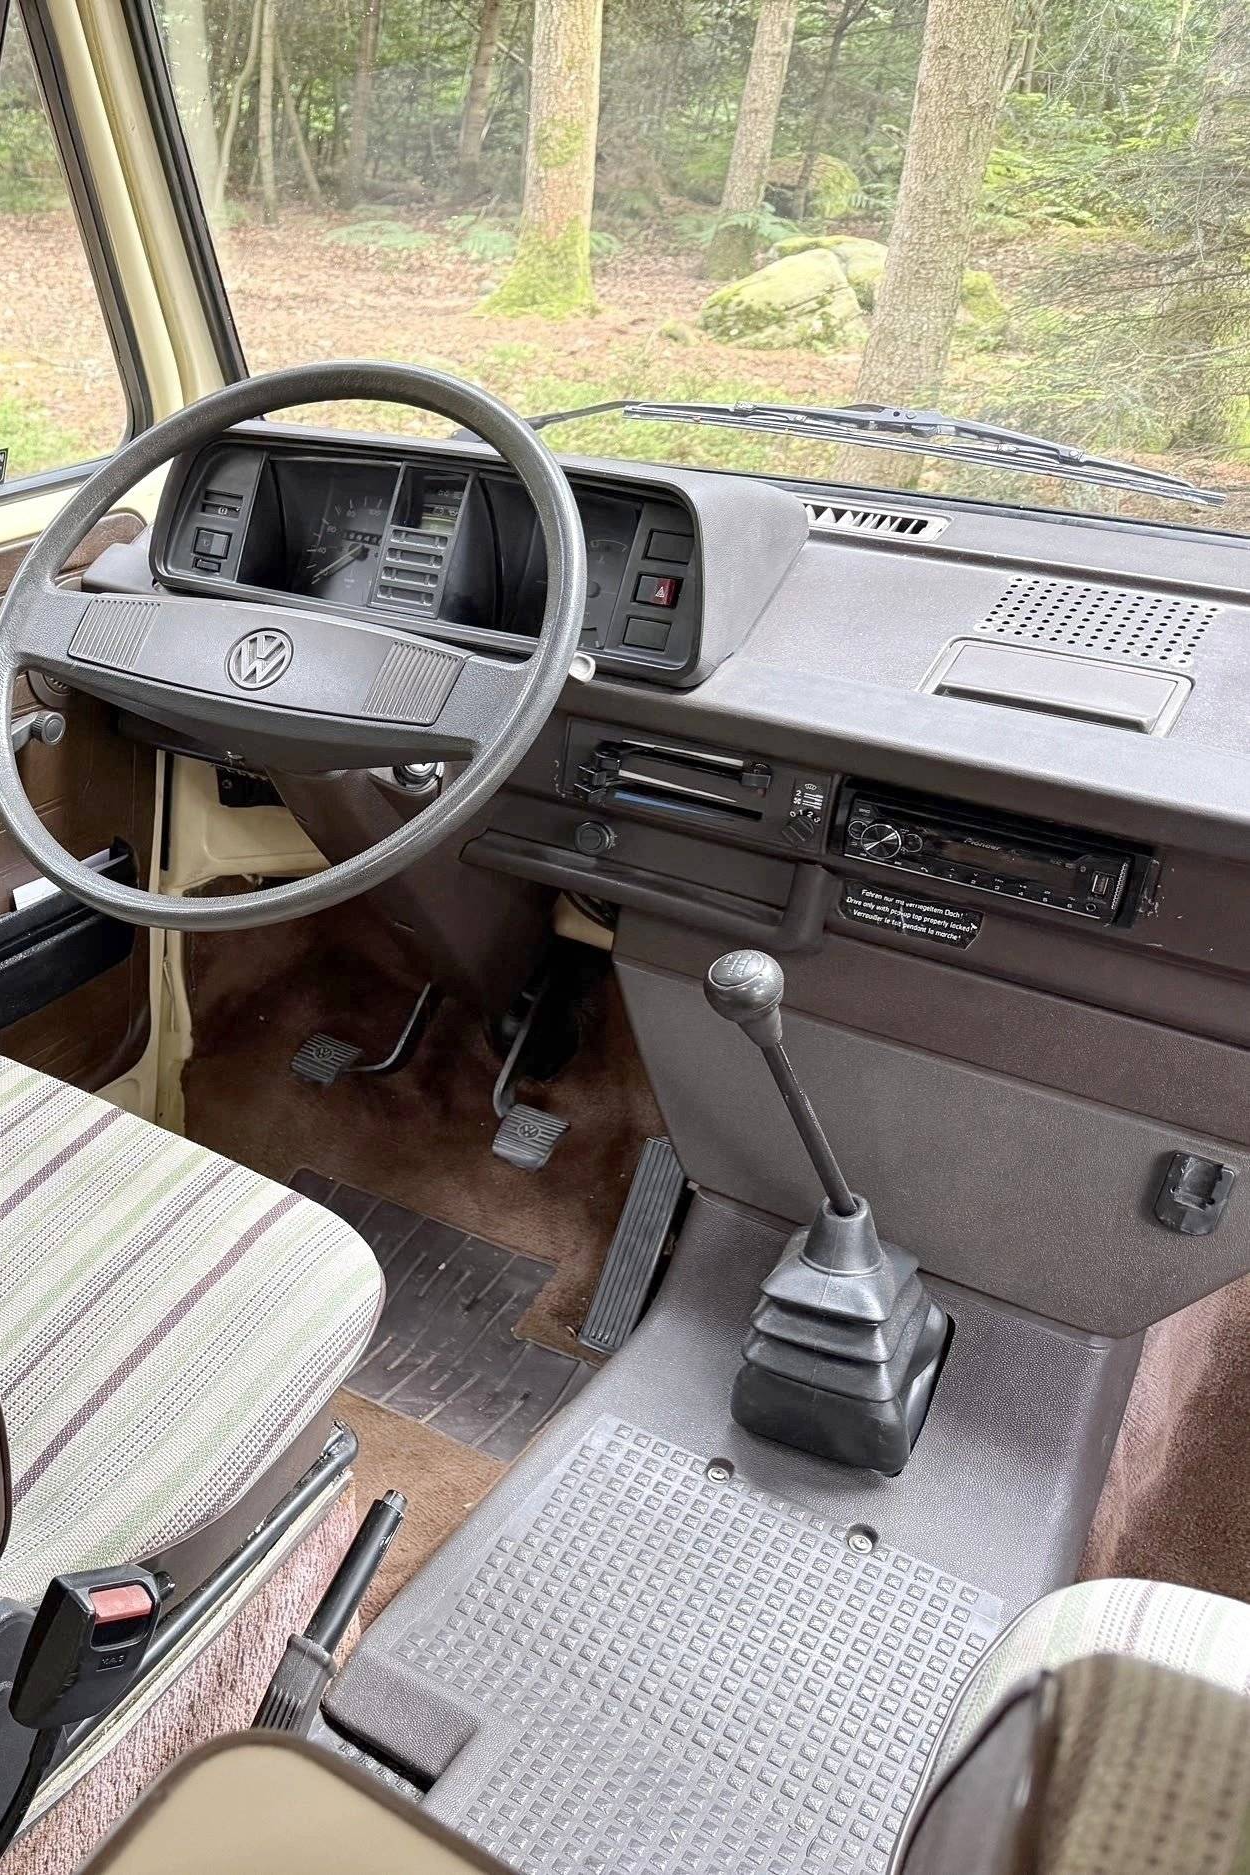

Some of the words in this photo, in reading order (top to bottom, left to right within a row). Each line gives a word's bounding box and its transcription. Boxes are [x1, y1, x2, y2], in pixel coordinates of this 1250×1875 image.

[228, 630, 292, 689] VW
[963, 837, 1002, 851] Pioneer
[861, 889, 882, 900] Fahren
[846, 896, 862, 906] Drive
[862, 902, 875, 910] only
[875, 904, 890, 912] with
[912, 913, 923, 921] top
[922, 917, 949, 929] properly
[902, 922, 927, 933] pendant
[927, 927, 935, 935] la
